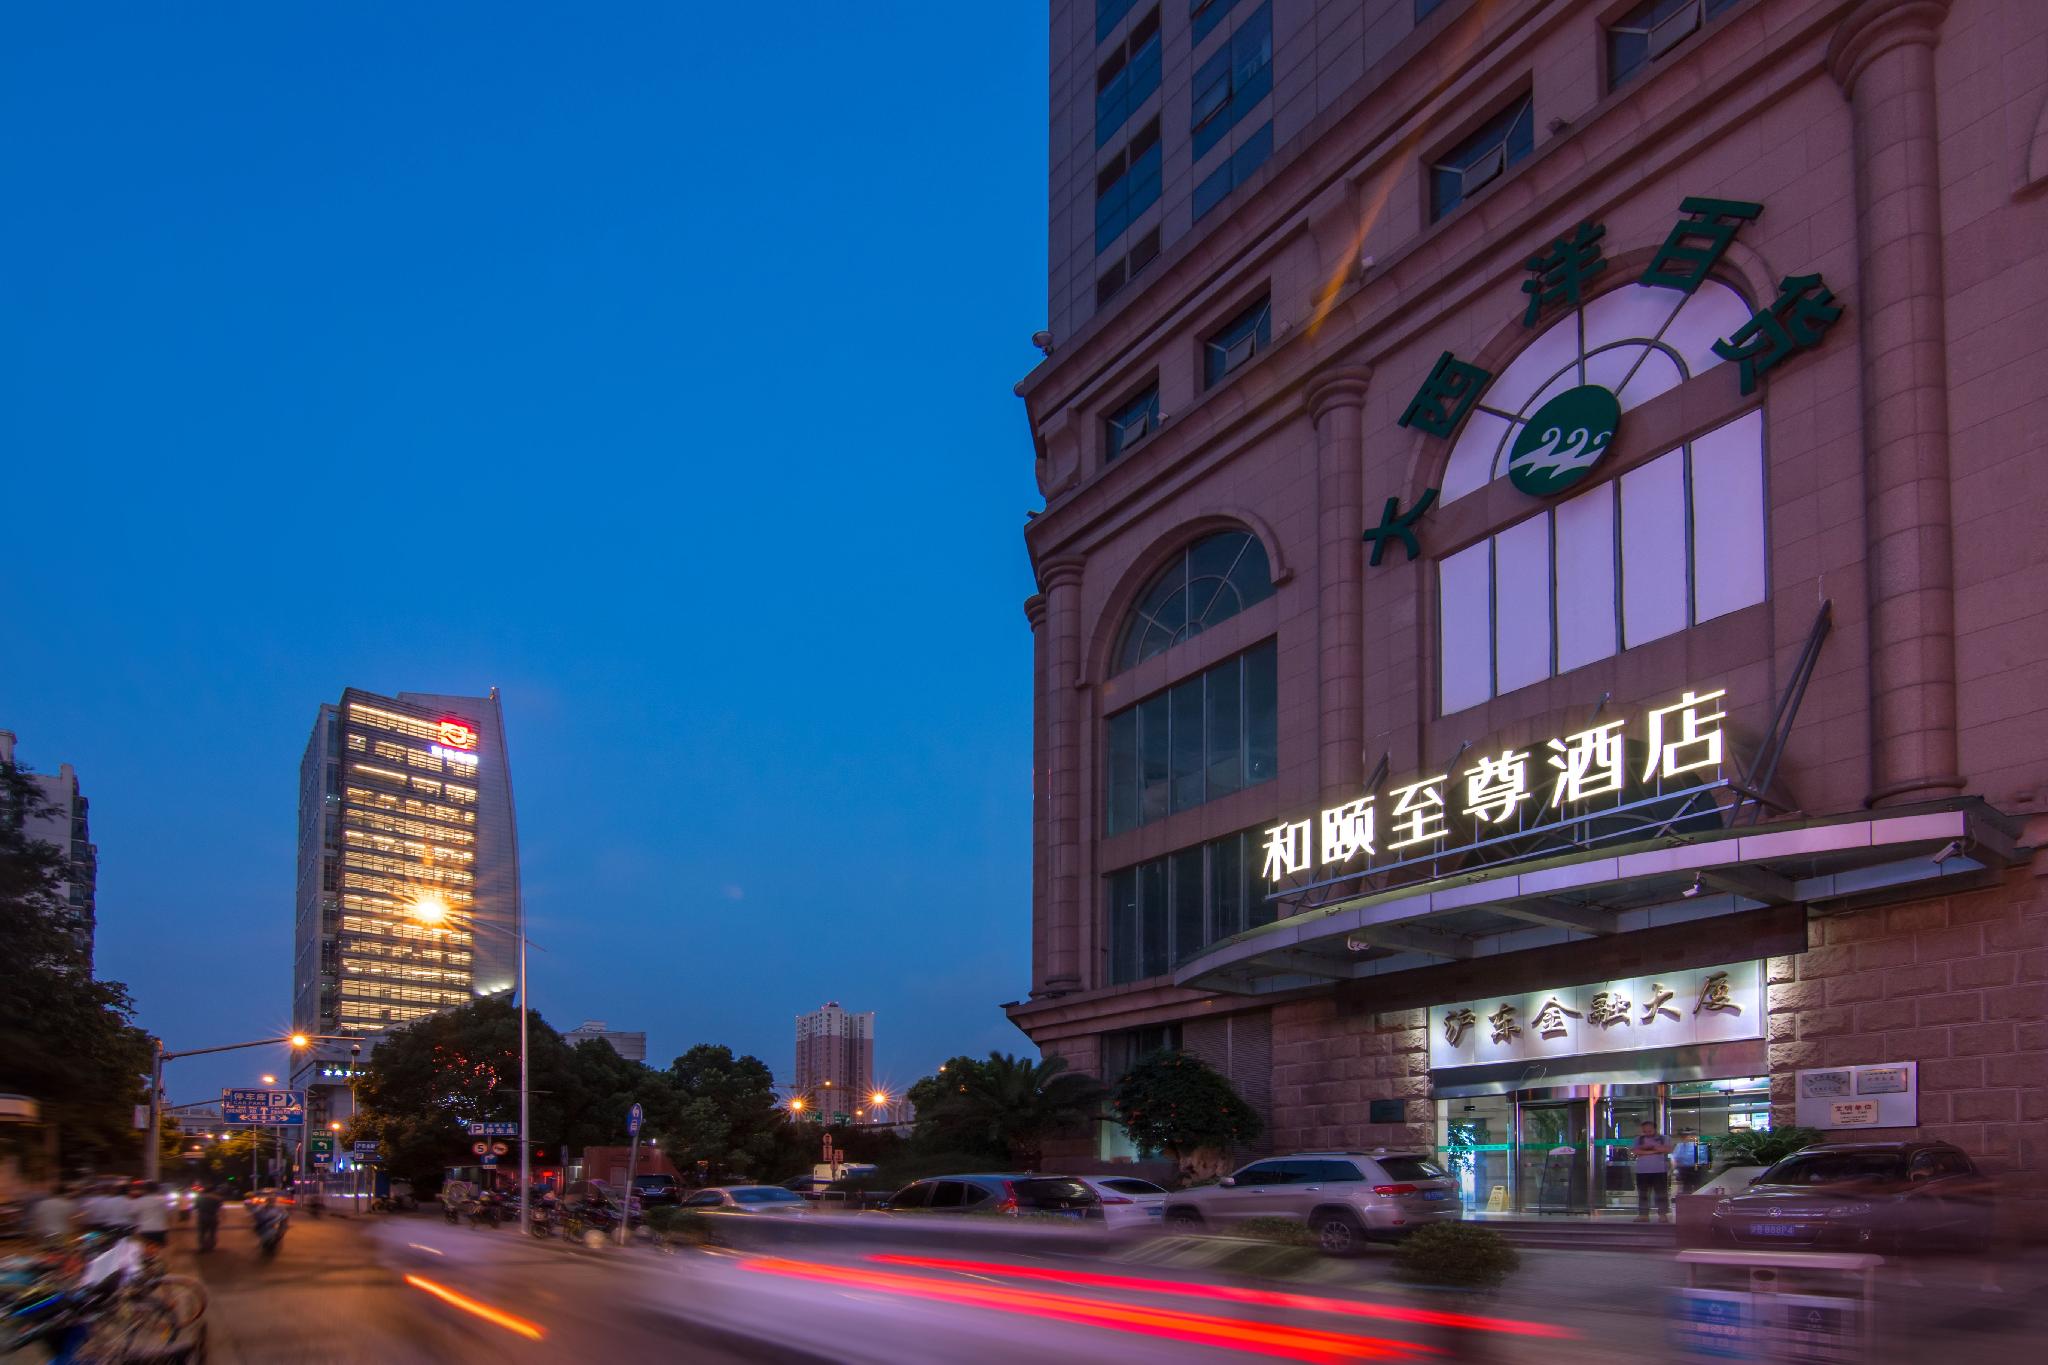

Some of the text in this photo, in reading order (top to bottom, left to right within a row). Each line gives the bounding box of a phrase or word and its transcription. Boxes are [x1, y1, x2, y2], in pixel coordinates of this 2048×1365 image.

[1363, 196, 1846, 567] 大西洋百货
[1261, 689, 1726, 882] 和颐至尊酒店
[1443, 971, 1742, 1048] 沪东金融大厦
